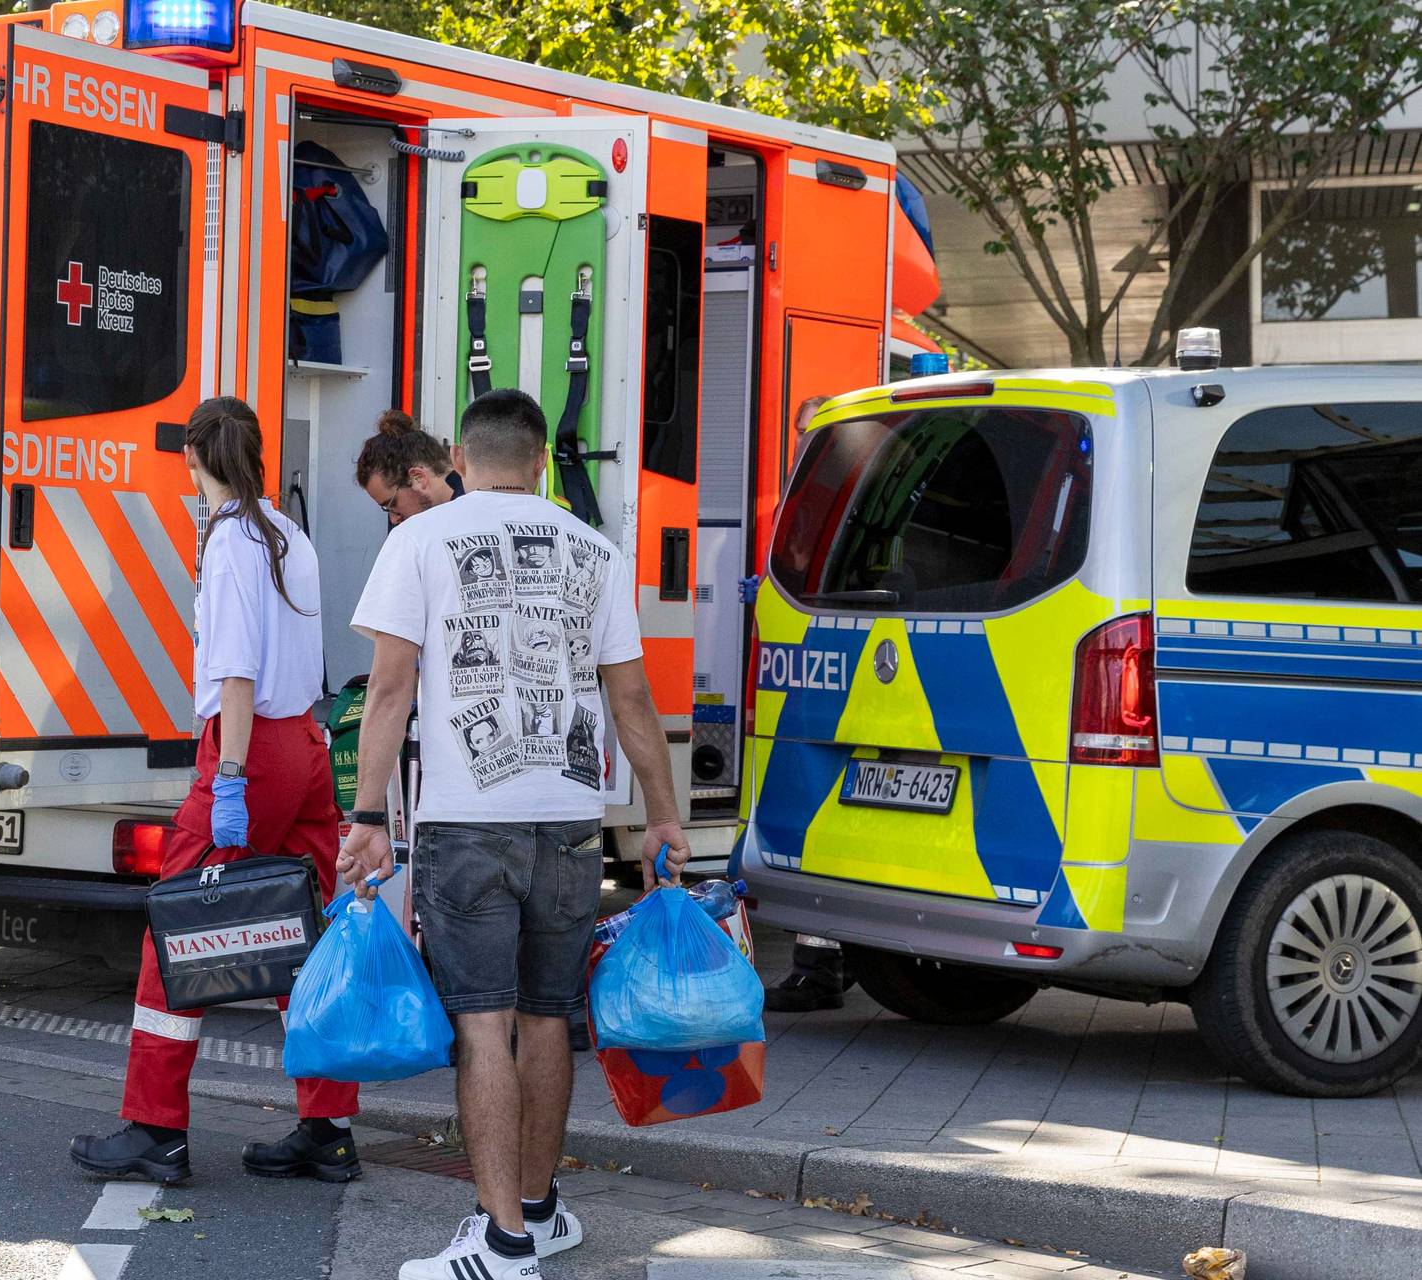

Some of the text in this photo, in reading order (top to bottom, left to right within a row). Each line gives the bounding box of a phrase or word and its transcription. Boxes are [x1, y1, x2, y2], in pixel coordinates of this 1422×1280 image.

[13, 59, 157, 131] HR ESSEN
[98, 265, 162, 295] Deutsches
[98, 287, 134, 312] Rotes
[97, 308, 134, 333] Kreuz
[2, 431, 138, 484] SDIENST
[446, 534, 500, 552] WANTED
[504, 523, 559, 537] WANTED
[566, 533, 611, 562] WANTED
[444, 614, 500, 633] WANTED
[455, 674, 473, 686] GOD
[474, 672, 500, 684] USOPP
[757, 647, 847, 691] POLIZEI
[516, 686, 564, 703] WANTED
[450, 696, 500, 730] WANTED
[525, 743, 559, 757] FRANKY
[473, 758, 487, 769] DEAD
[476, 761, 496, 777] NICO
[495, 750, 520, 769] ROBIN
[852, 764, 955, 803] NRW 5-6423
[167, 925, 302, 957] MANV-Tasche
